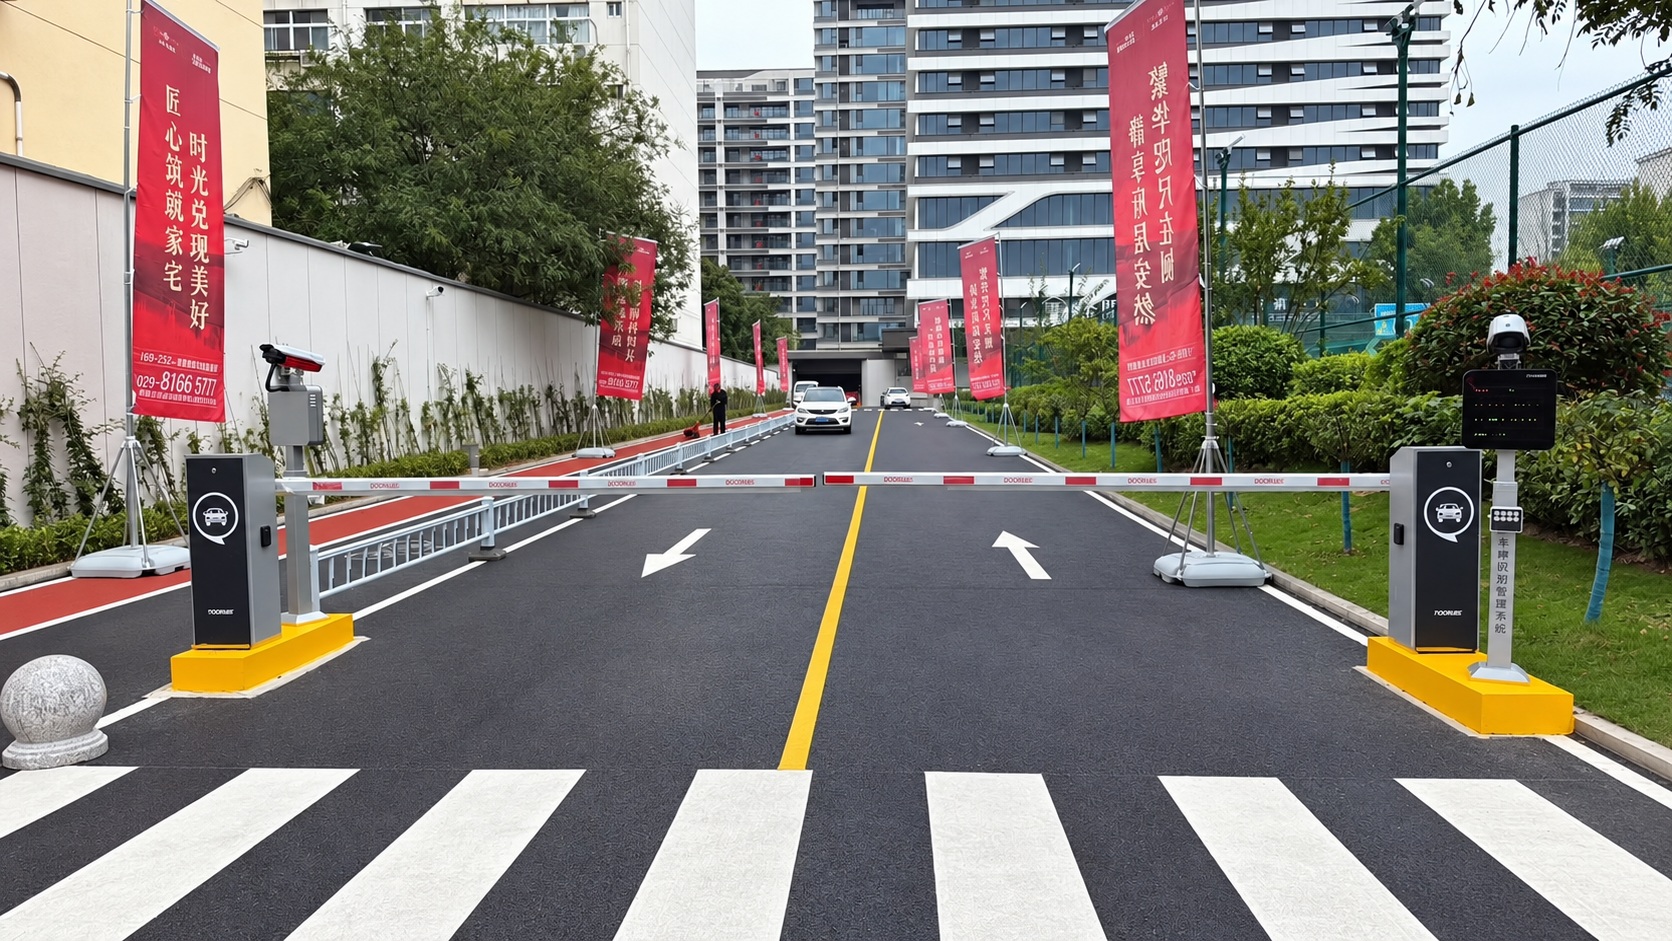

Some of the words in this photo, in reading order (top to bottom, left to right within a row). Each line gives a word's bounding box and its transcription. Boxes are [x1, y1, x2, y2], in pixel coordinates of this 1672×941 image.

[189, 131, 209, 330] 时光兑现美好
